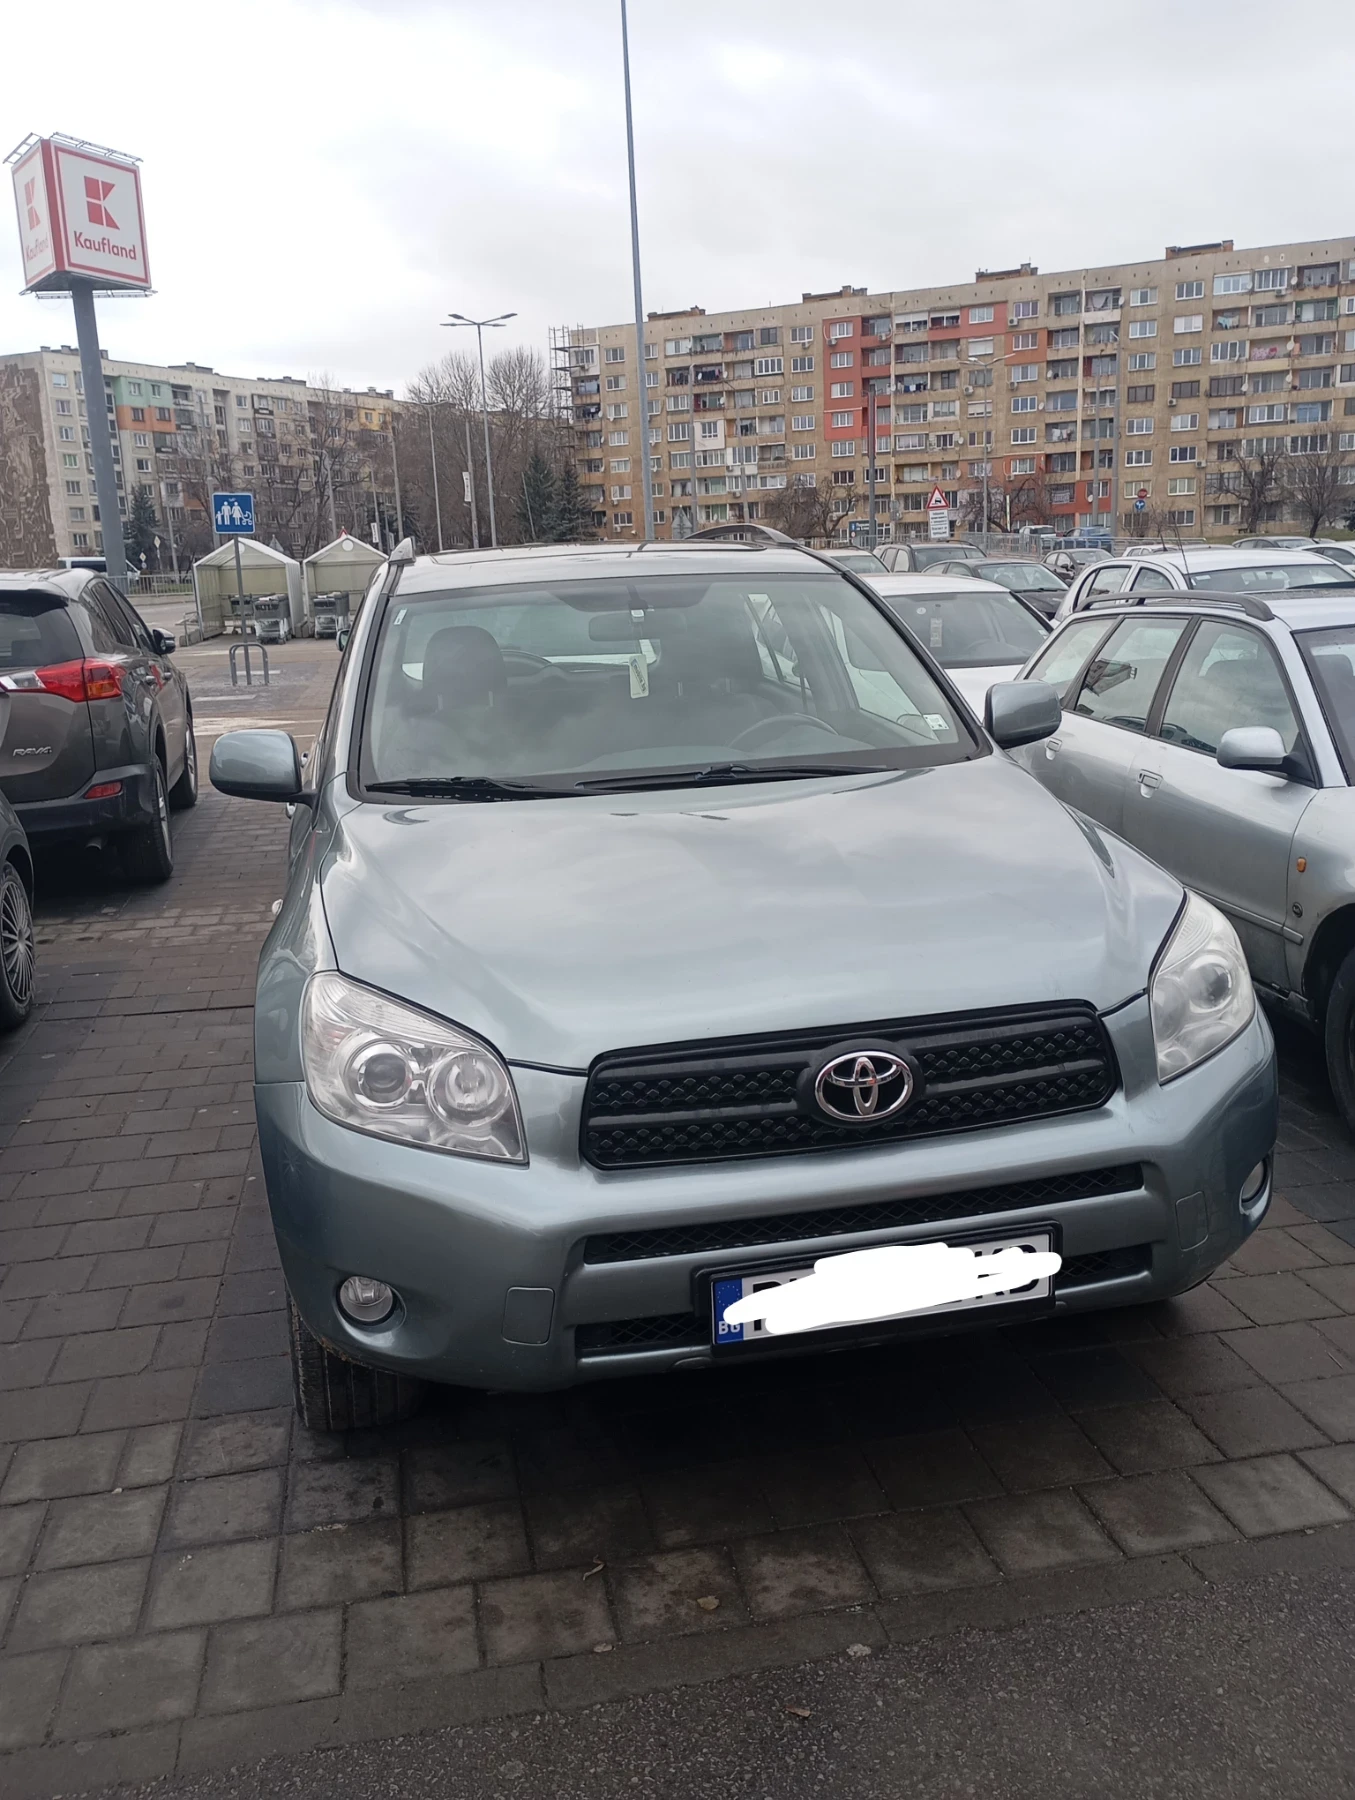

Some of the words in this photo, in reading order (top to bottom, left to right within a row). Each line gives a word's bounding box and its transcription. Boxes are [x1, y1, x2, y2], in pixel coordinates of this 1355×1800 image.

[84, 176, 120, 230] K
[26, 237, 49, 262] Kaufland
[74, 231, 137, 260] Kaufland
